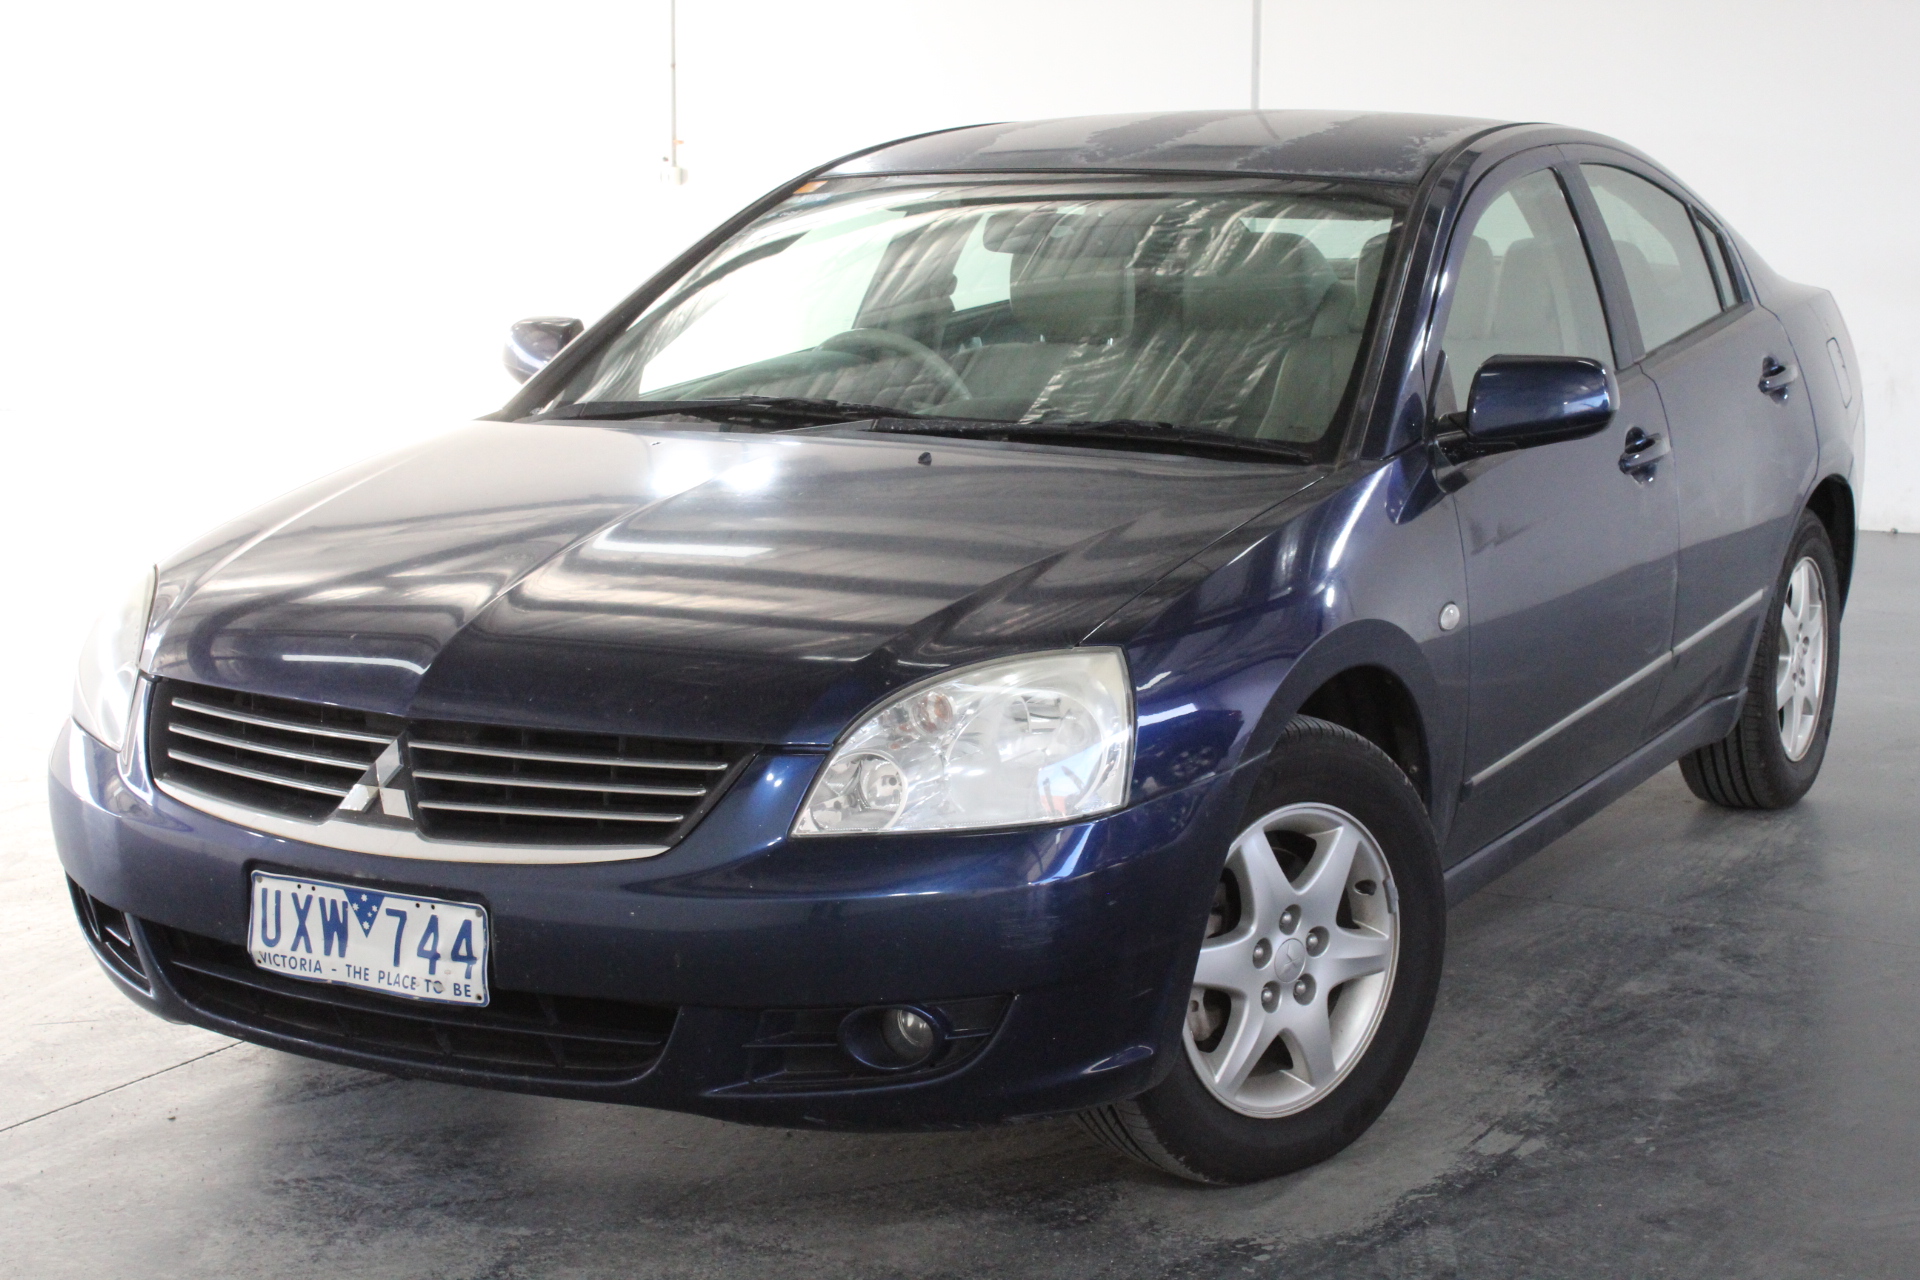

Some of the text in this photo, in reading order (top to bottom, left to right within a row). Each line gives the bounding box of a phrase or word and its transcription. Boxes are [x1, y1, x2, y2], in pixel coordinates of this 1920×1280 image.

[261, 887, 477, 979] UXW 744
[259, 951, 323, 974] VICTORIA
[345, 964, 370, 982] THE
[378, 970, 417, 991] PLACE
[453, 983, 472, 997] BE
